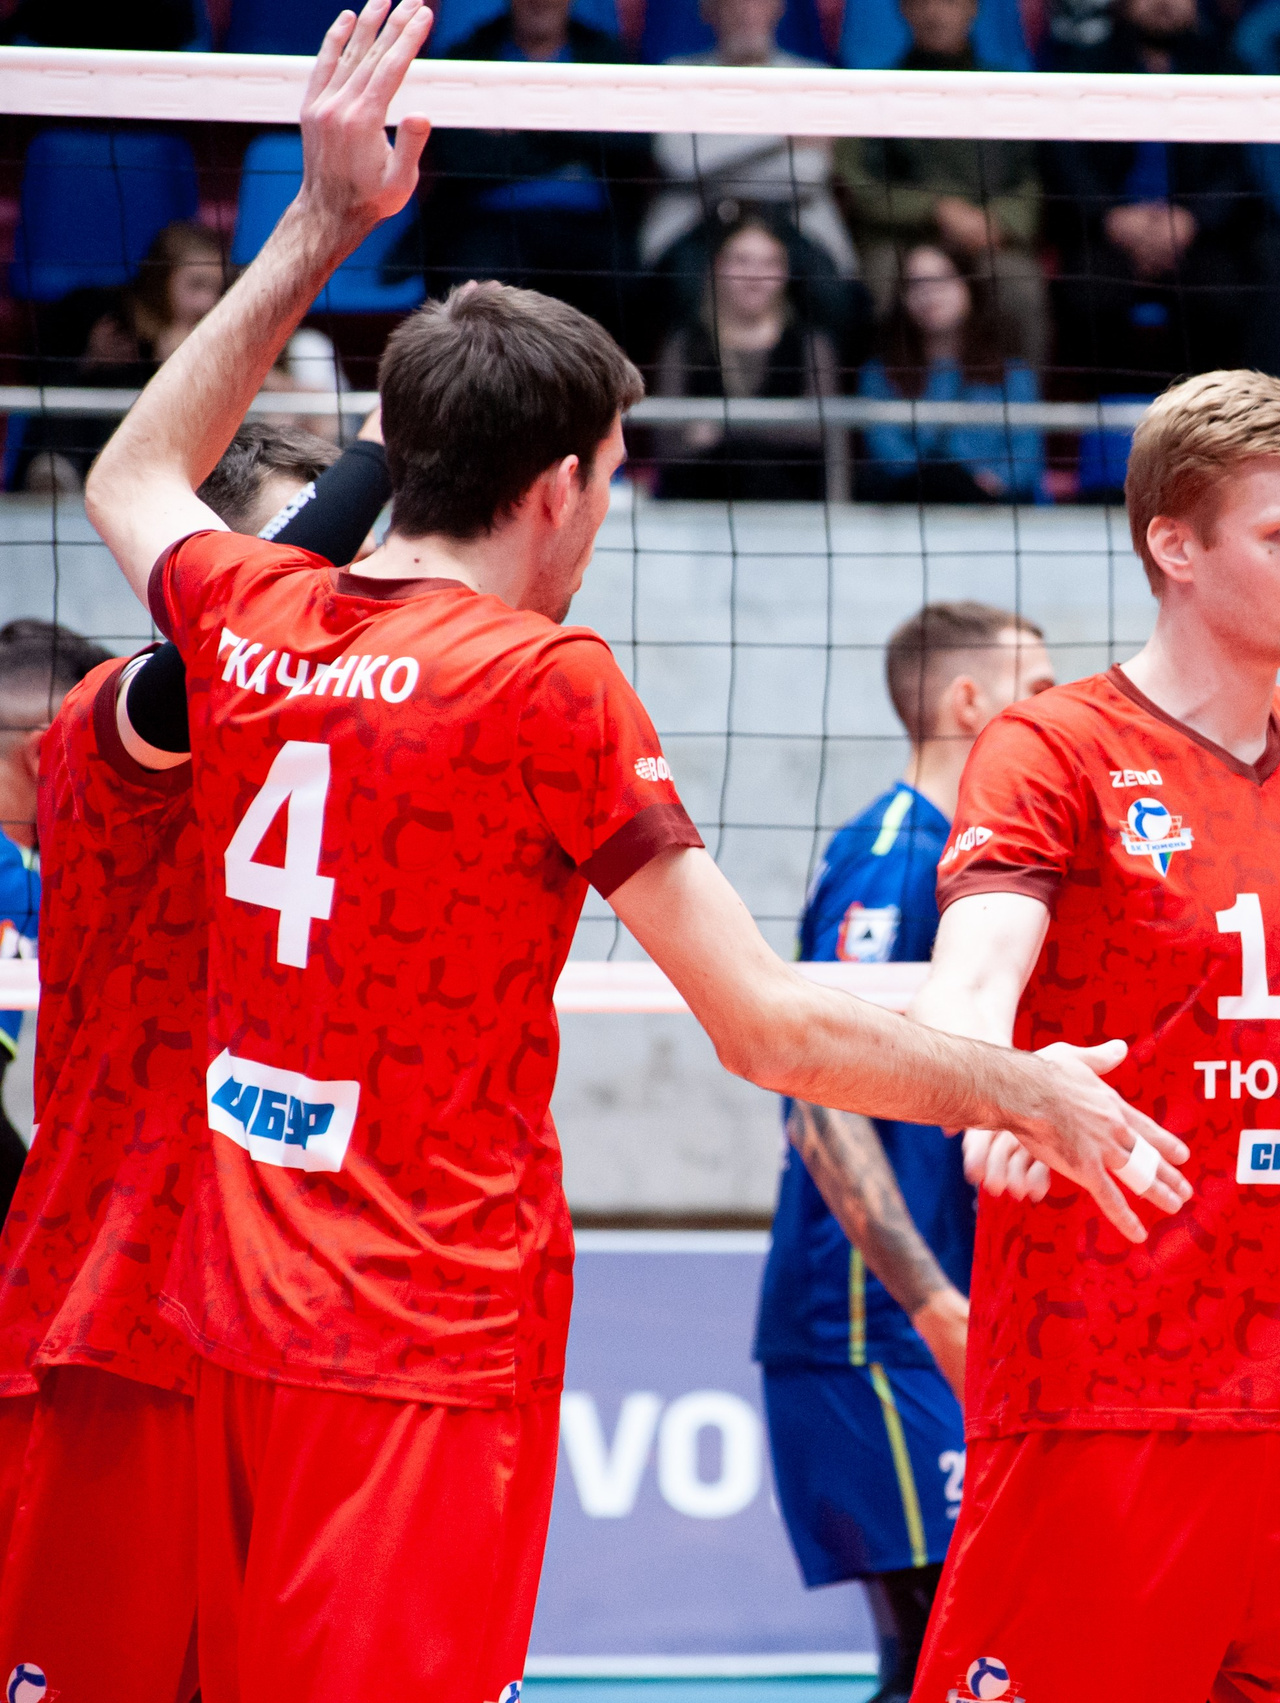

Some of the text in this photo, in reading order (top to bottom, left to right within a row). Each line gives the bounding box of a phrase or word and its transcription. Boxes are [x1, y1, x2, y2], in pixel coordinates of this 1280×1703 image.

[1109, 769, 1163, 788] ZEDO
[224, 740, 335, 969] 4
[561, 1388, 776, 1520] VO
[938, 1449, 967, 1502] 2
